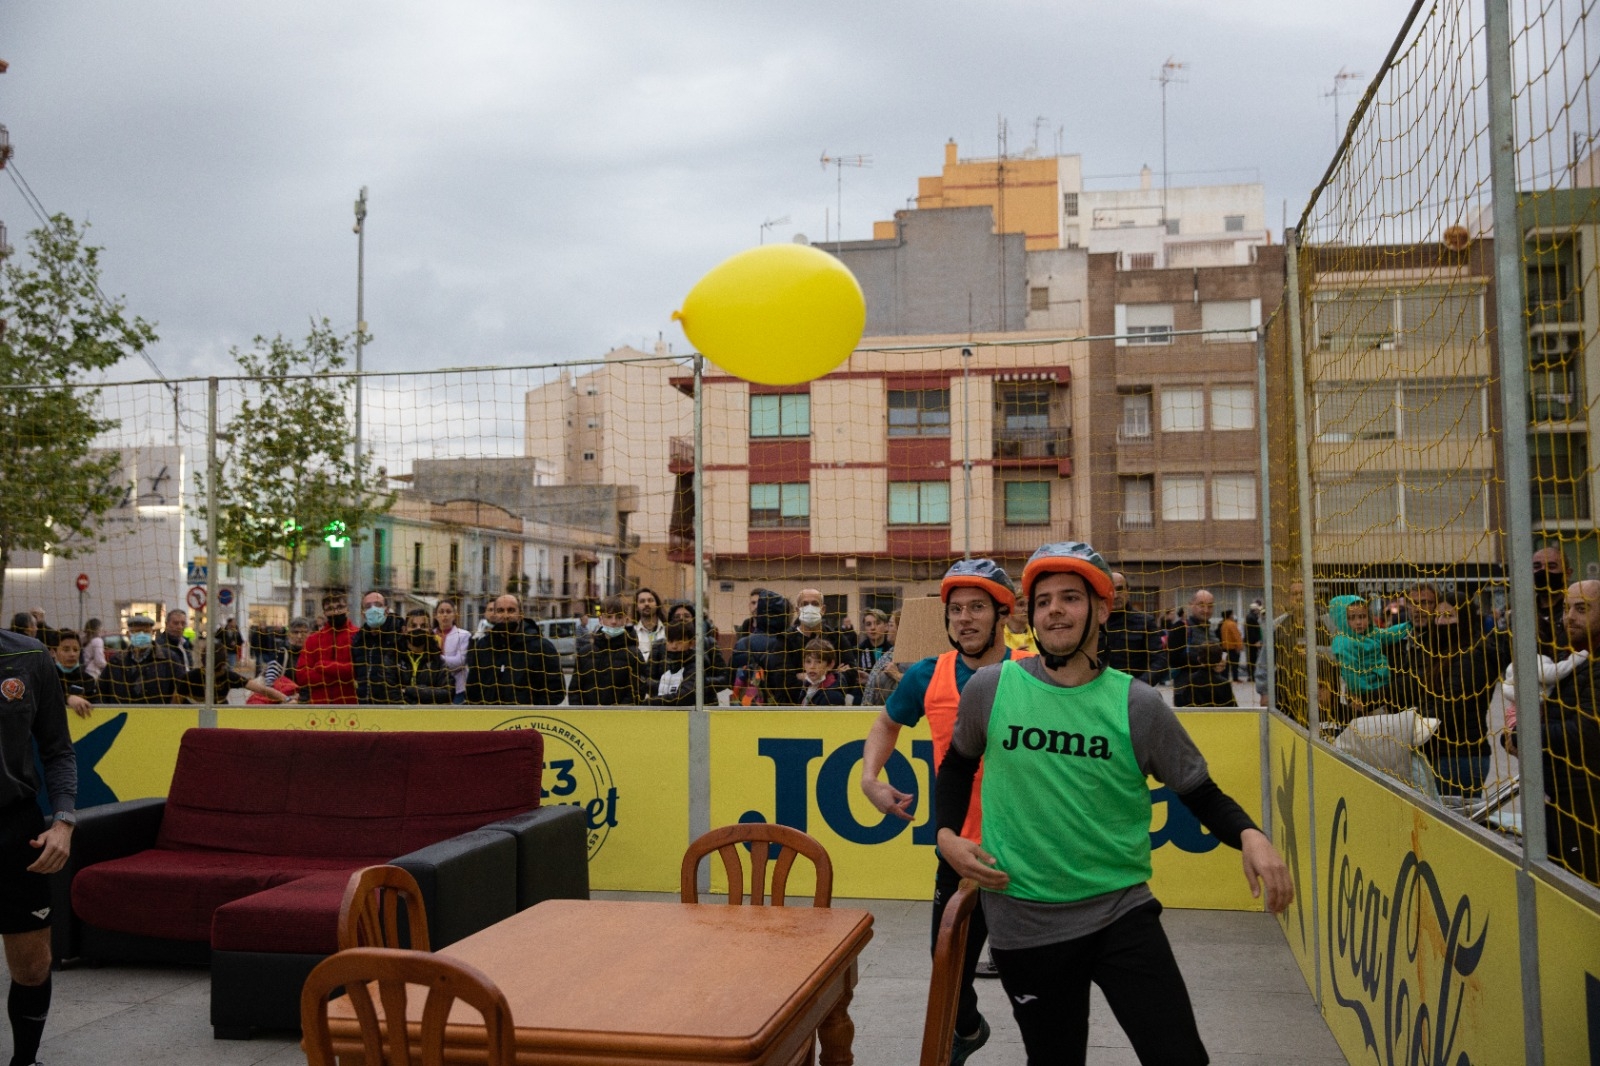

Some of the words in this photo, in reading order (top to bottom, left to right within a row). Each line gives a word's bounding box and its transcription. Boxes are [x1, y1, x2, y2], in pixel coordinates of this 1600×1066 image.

[1357, 582, 1382, 593] BAR
[530, 722, 585, 750] VILLARREAL
[586, 750, 597, 762] CF
[1002, 724, 1113, 761] Joma
[541, 759, 577, 798] 3
[738, 737, 1222, 860] Joa
